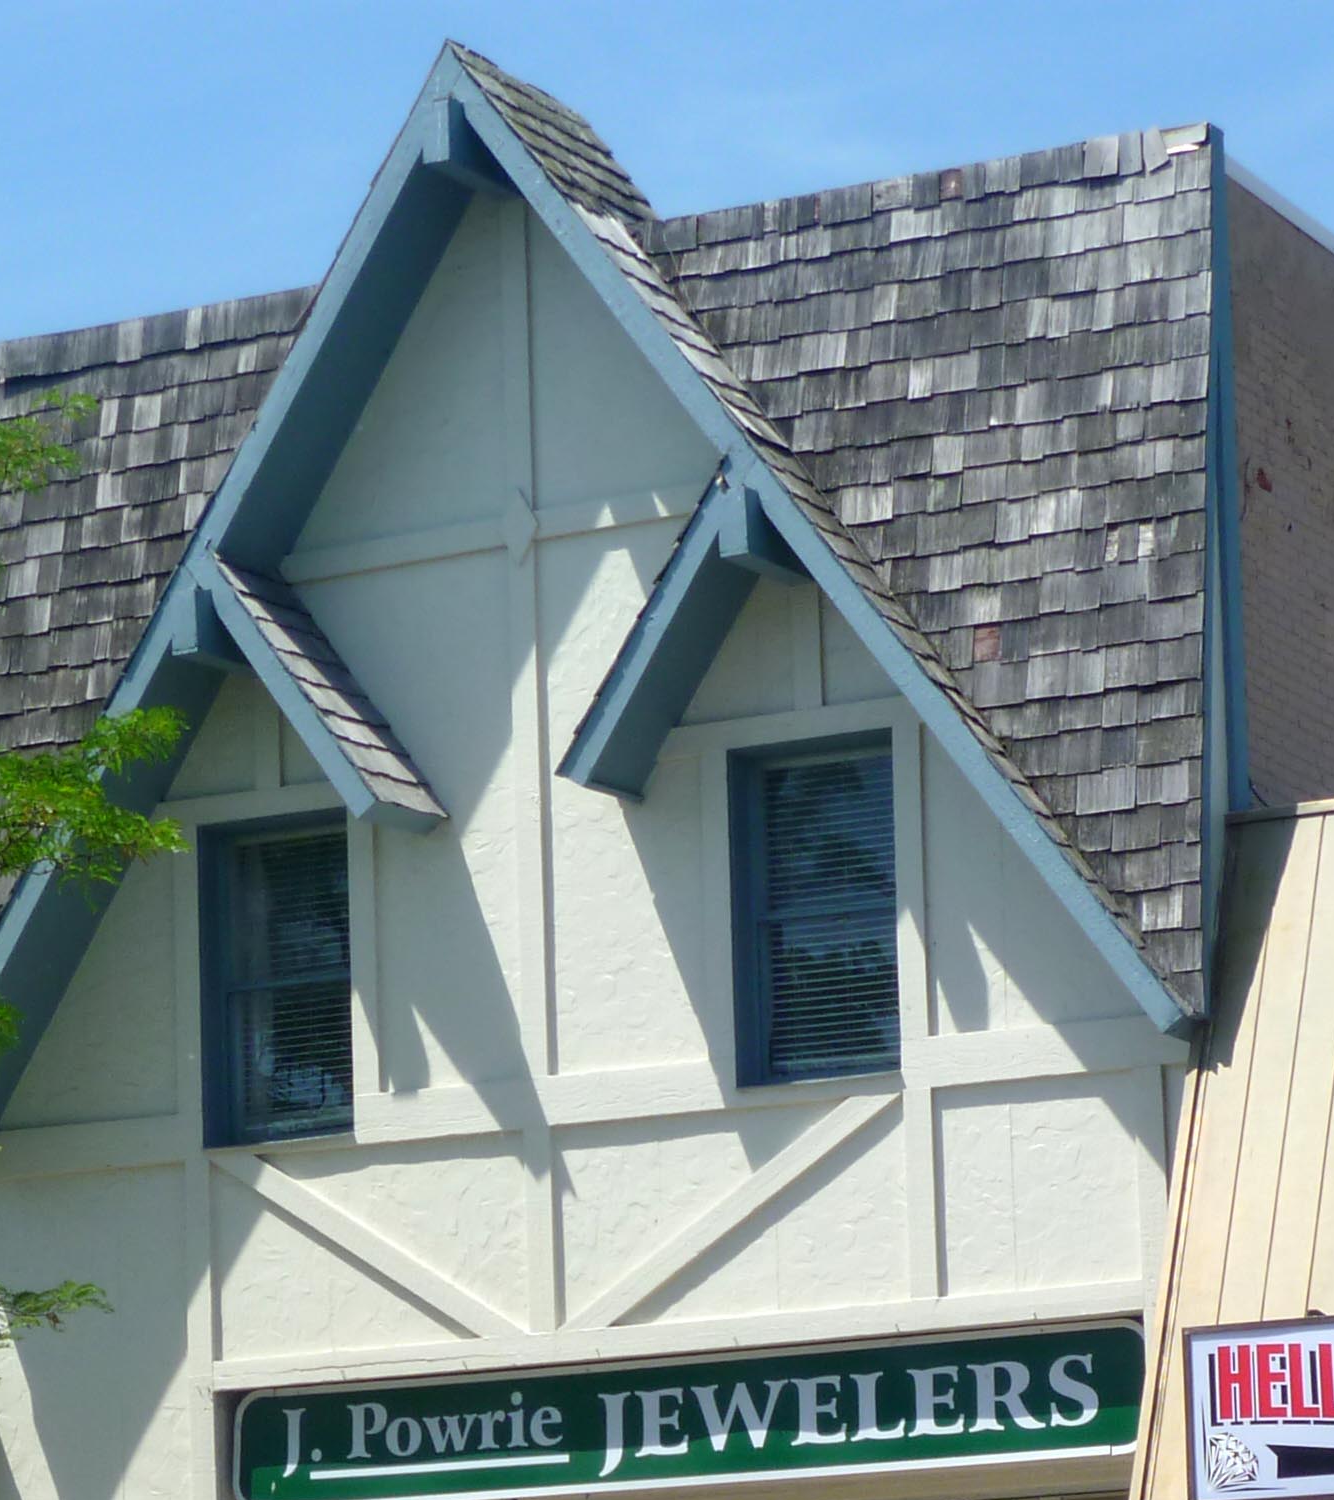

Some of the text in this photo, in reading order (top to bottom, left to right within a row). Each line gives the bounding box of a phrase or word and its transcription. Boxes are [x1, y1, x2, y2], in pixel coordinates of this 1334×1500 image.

[282, 1353, 1100, 1478] J. Powrie JEWELERS
